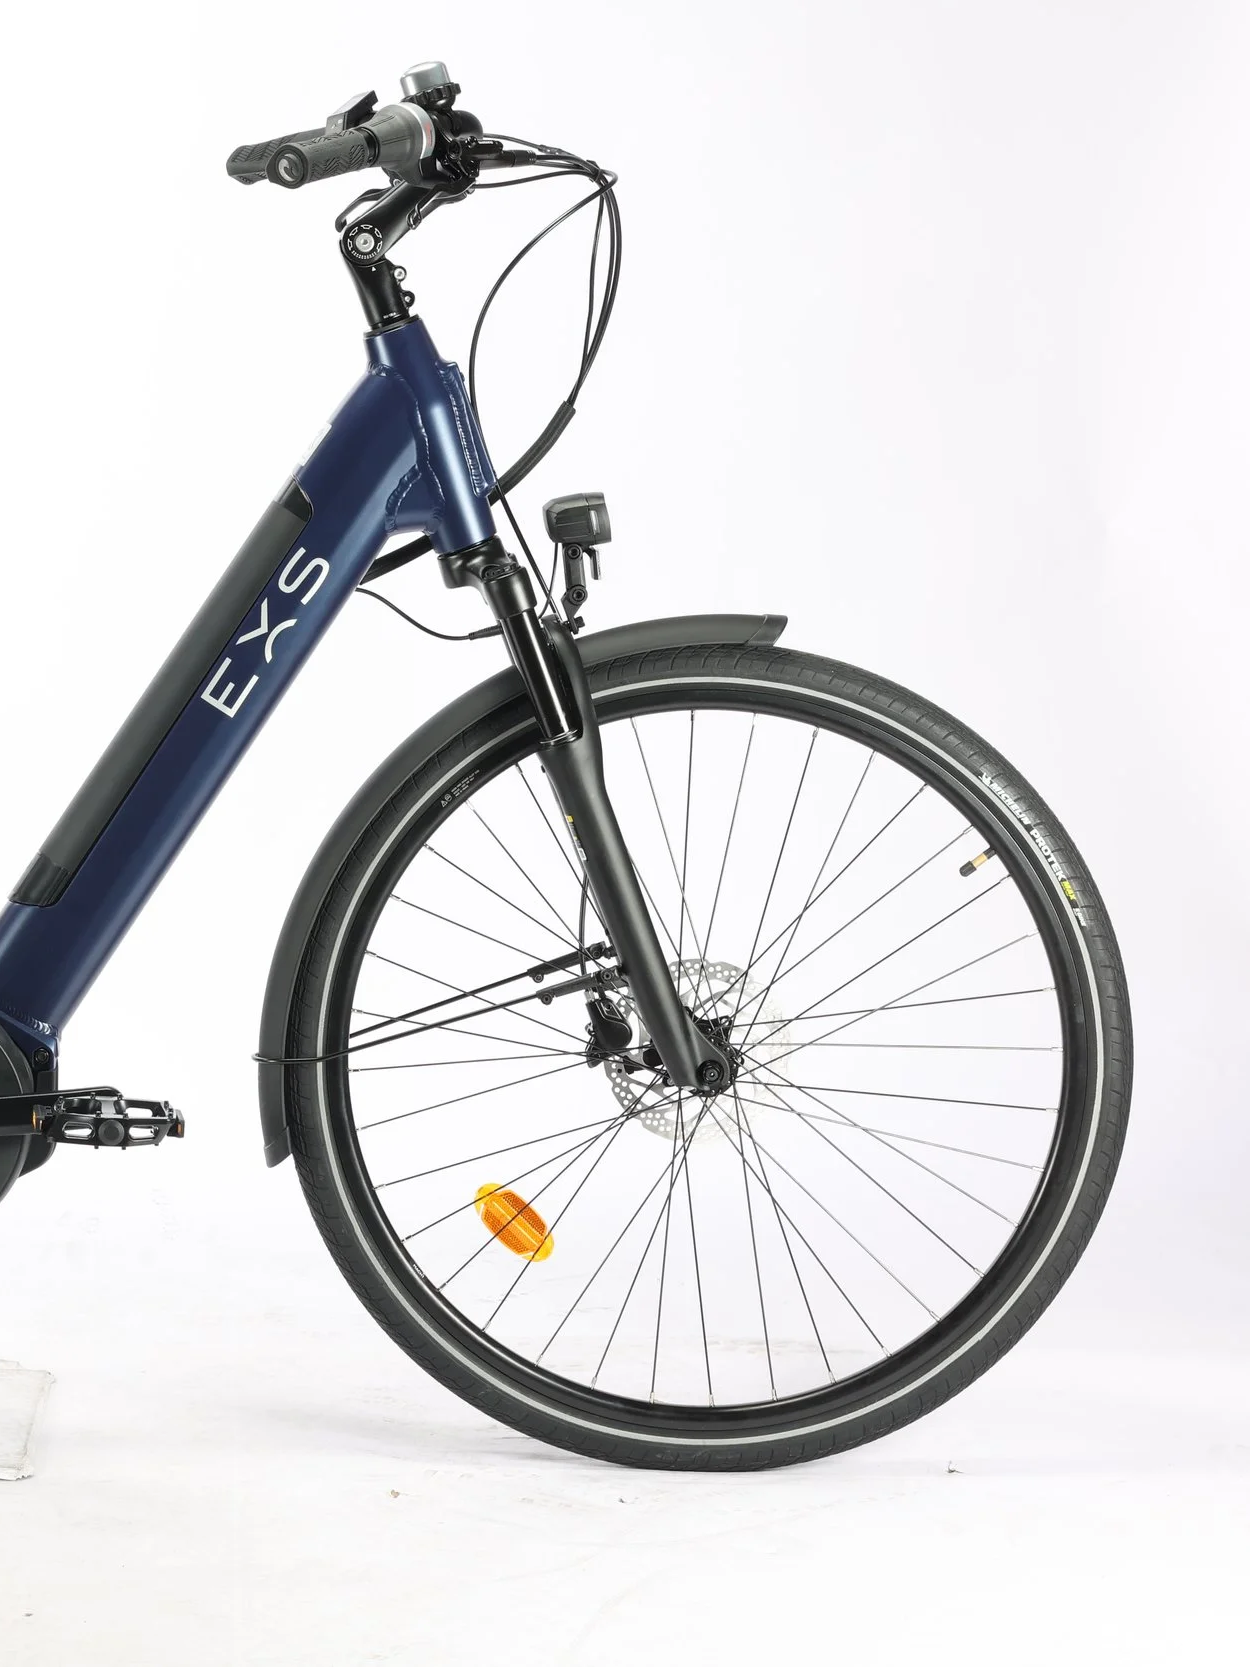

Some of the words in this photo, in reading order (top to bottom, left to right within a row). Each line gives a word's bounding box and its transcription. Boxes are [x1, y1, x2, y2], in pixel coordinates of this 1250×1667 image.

[200, 547, 330, 718] EXS
[990, 782, 1031, 825] MICHELIN
[1030, 828, 1067, 882] PROTEK
